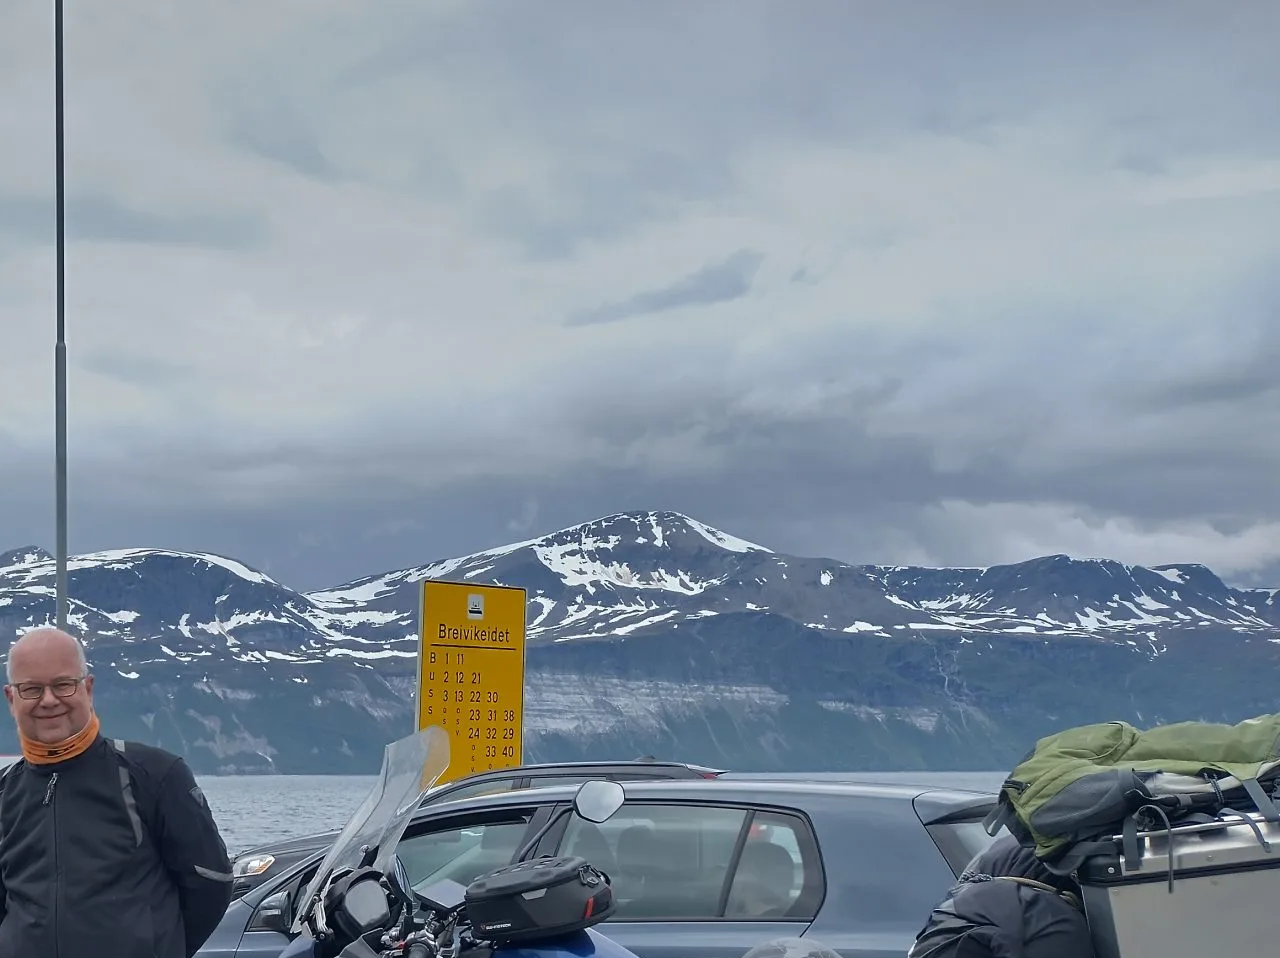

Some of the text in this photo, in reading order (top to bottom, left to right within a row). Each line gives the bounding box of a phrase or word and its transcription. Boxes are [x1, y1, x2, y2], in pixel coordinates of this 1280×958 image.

[438, 623, 510, 643] Breivikeidet
[445, 652, 464, 665] 1 11
[443, 671, 481, 685] 2 12 21
[442, 689, 499, 703] 3 13 22 30
[469, 709, 515, 722] 23 31 38
[468, 727, 515, 740] 24 32 29
[485, 745, 515, 758] 33 40
